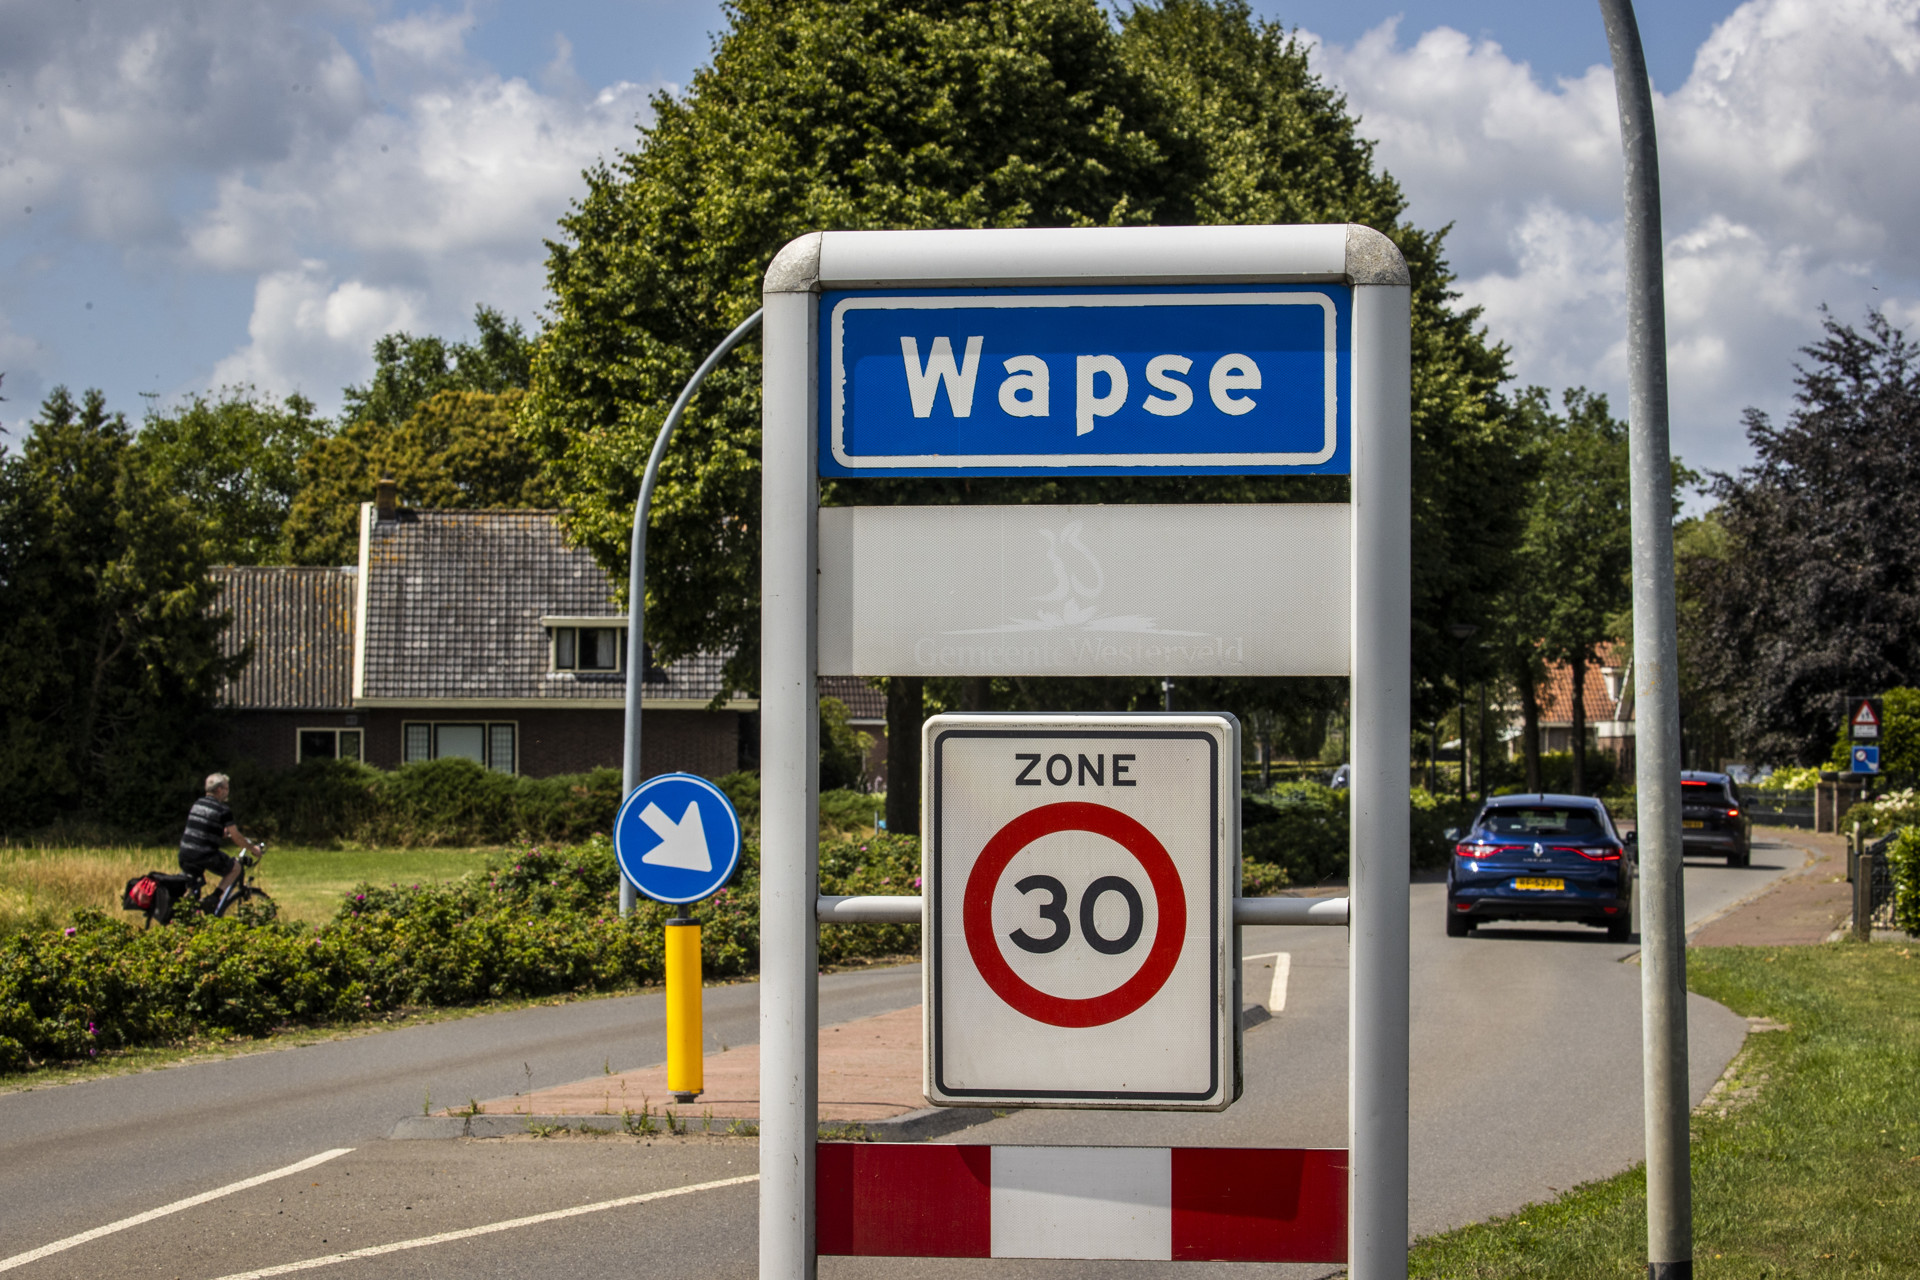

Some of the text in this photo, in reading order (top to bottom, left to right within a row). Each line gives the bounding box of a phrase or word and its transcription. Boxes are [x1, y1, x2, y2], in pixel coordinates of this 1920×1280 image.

[900, 336, 1262, 436] Wapse
[1069, 637, 1245, 667] Westerveld
[1015, 753, 1137, 786] ZONE
[1008, 874, 1144, 955] 30
